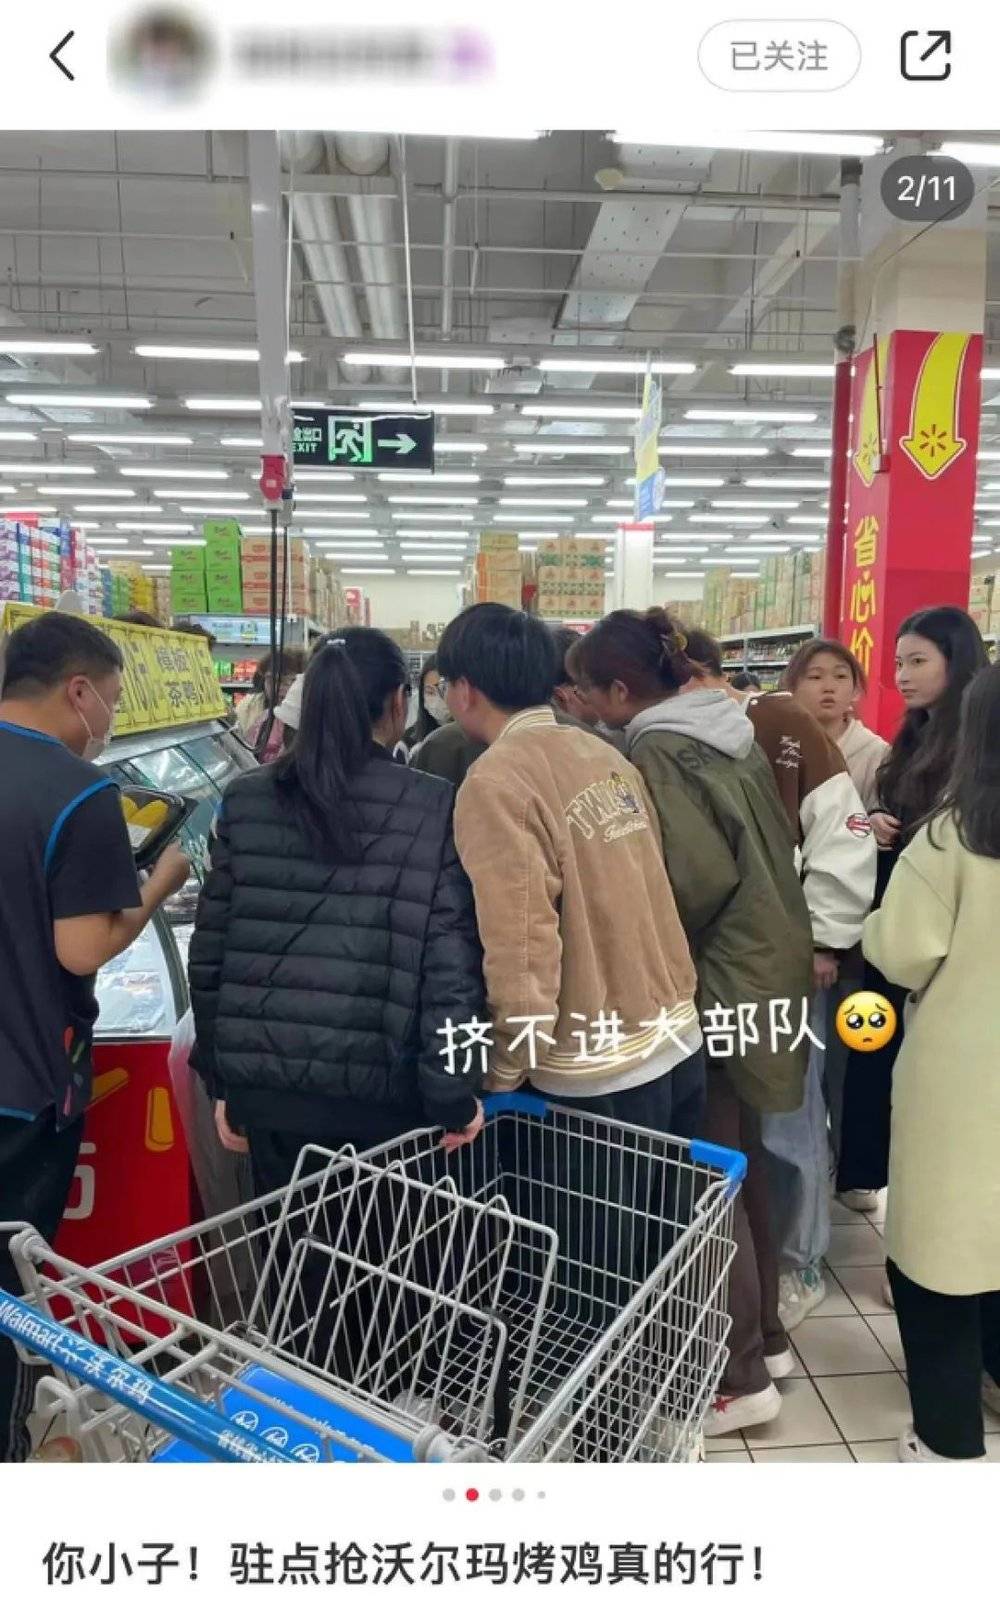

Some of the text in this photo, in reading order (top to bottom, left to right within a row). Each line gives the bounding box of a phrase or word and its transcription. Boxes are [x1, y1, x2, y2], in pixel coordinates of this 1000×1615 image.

[292, 442, 317, 453] EXIT
[850, 515, 878, 676] 省心价
[0, 1300, 64, 1352] Walmart
[83, 1353, 154, 1405] 沃尔玛
